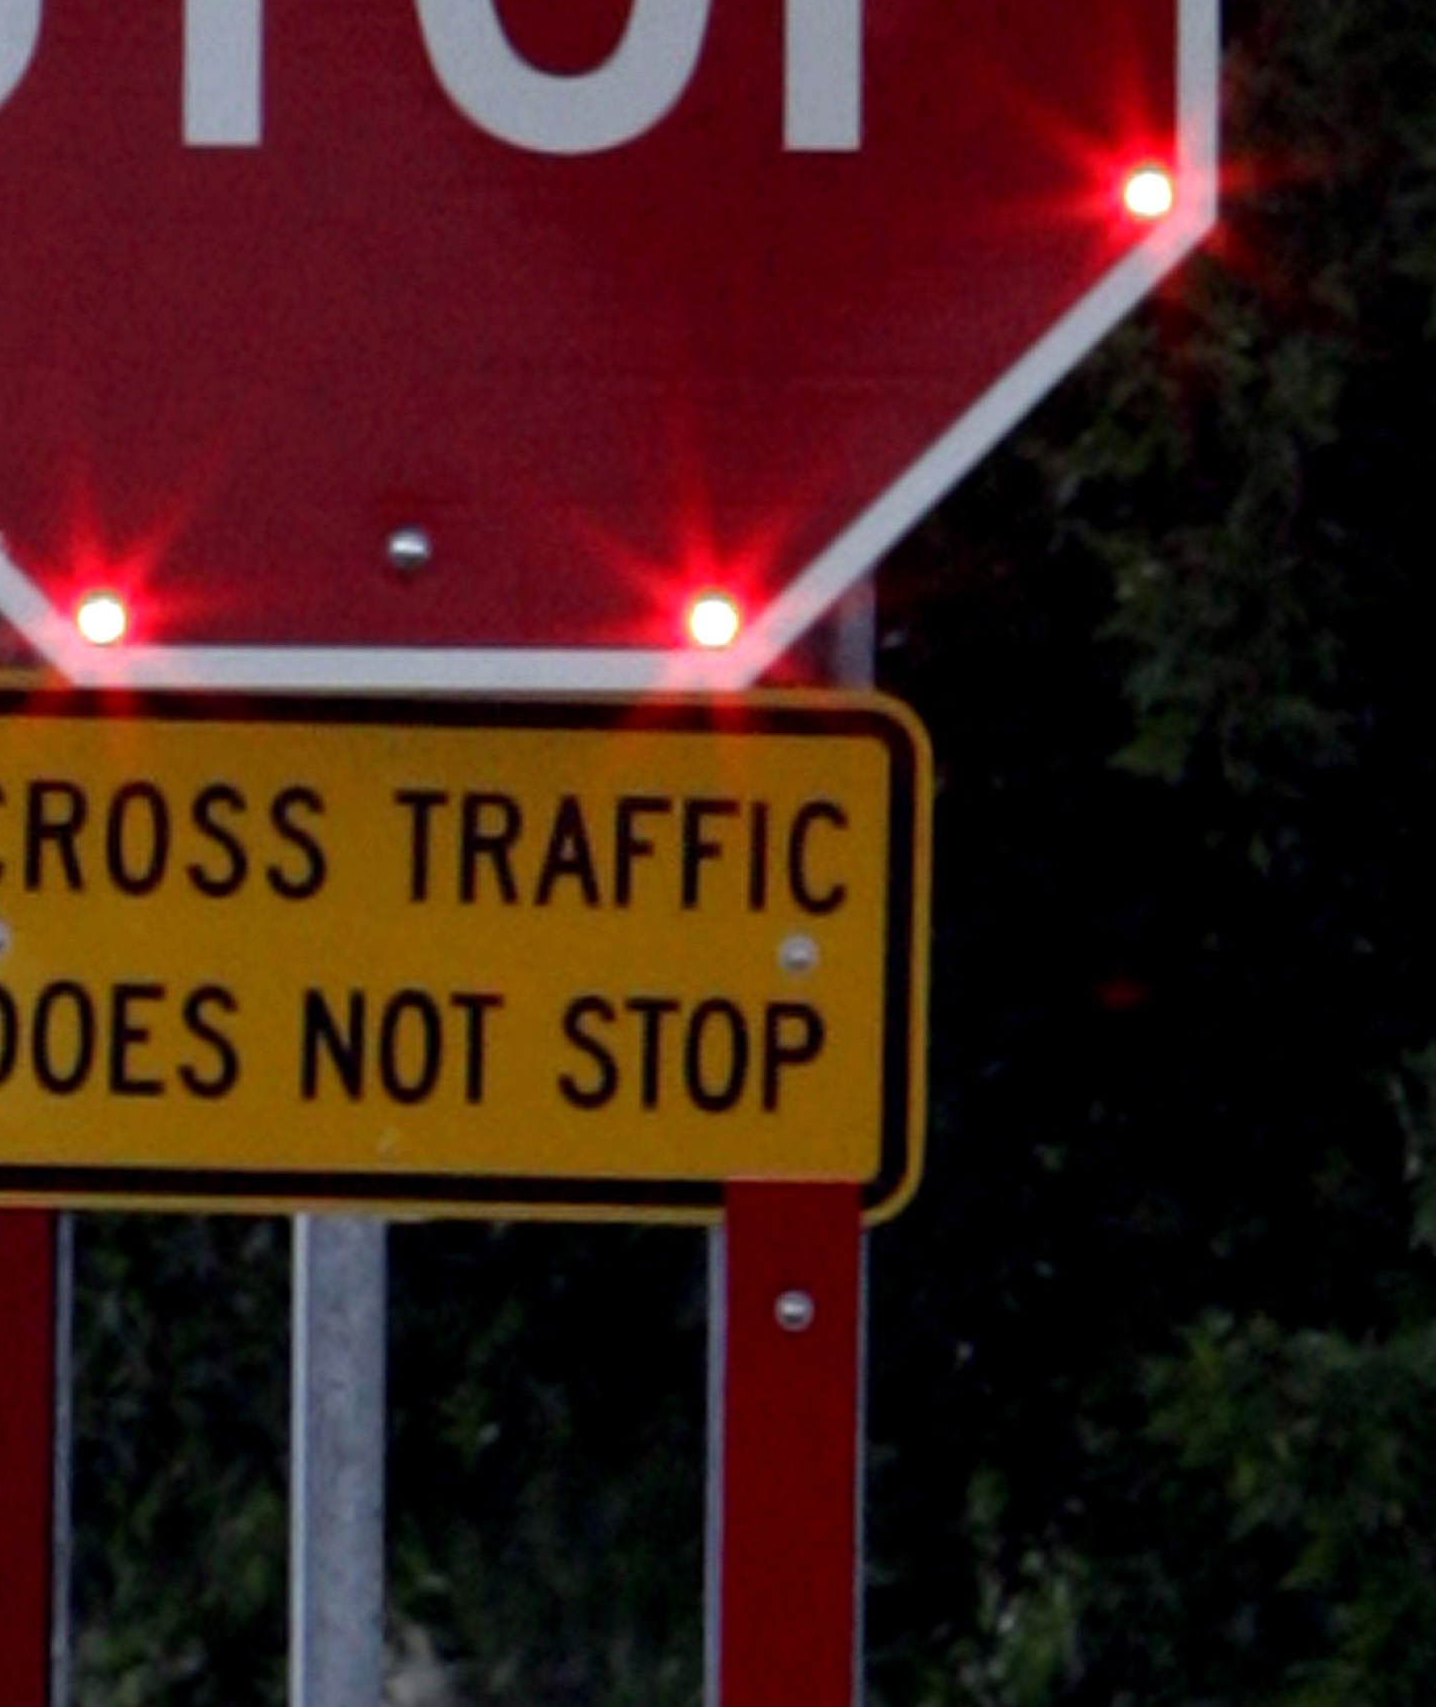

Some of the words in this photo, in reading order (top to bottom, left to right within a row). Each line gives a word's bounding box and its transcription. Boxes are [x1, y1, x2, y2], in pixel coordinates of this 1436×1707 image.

[394, 790, 850, 915] TRAFFIC
[299, 988, 504, 1106] NOT
[556, 995, 828, 1112] STOP
